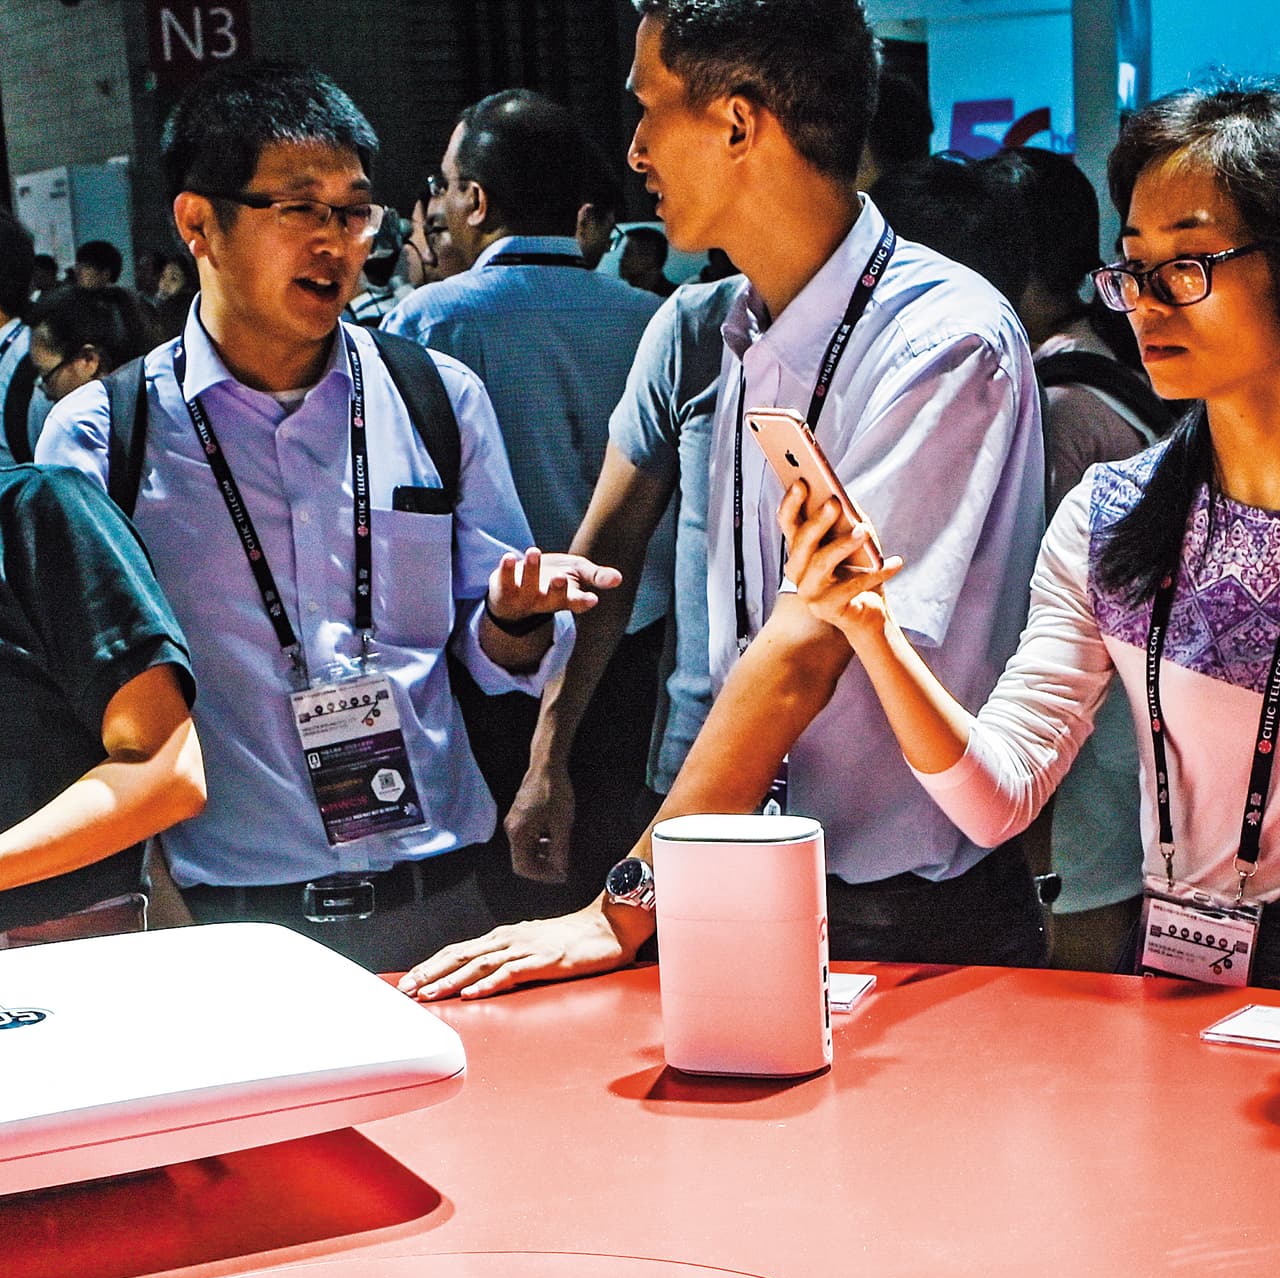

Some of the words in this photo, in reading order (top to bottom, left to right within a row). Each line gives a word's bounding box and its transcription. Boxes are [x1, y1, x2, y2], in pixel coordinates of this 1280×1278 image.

[160, 7, 238, 61] N3
[869, 250, 888, 276] CITIC
[1149, 626, 1161, 679] TELECOM
[1150, 681, 1158, 718] CITIC
[1262, 707, 1277, 739] CITIC
